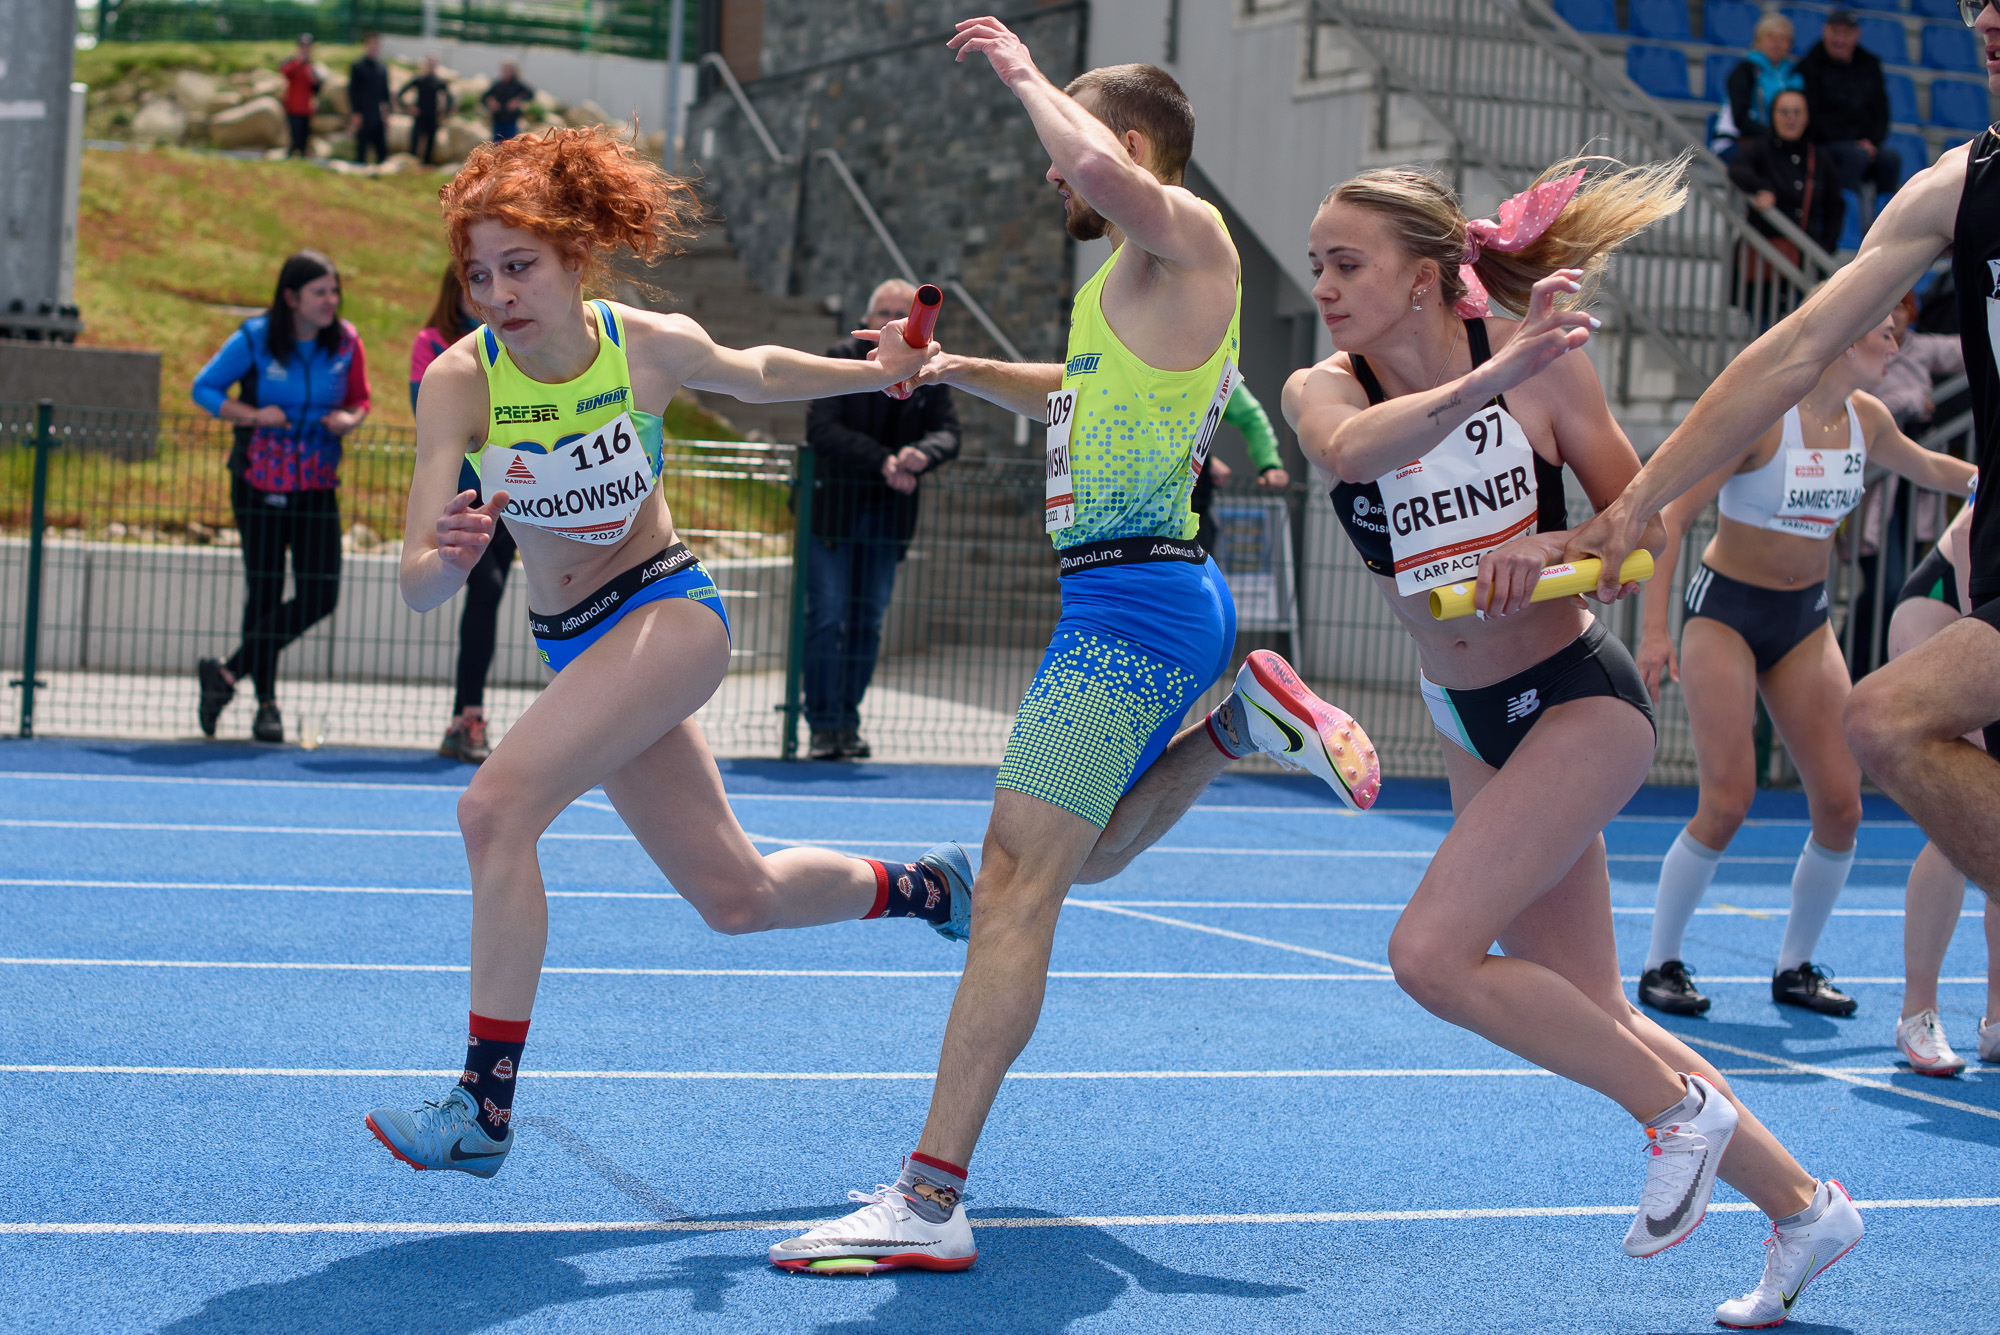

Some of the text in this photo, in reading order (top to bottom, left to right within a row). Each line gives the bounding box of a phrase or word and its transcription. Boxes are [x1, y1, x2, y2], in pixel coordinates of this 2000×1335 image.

[1047, 394, 1072, 428] 109
[570, 421, 632, 471] 116
[1465, 411, 1503, 456] 97
[1396, 467, 1423, 480] KARPACZ
[1844, 453, 1862, 474] 25
[501, 470, 648, 518] OKOŁOWSKA
[1392, 466, 1531, 537] GREINER
[590, 528, 624, 541] 2022
[1061, 549, 1123, 569] dRunaLine
[1413, 554, 1481, 583] KARPACZ
[561, 591, 620, 633] AdRunaLine
